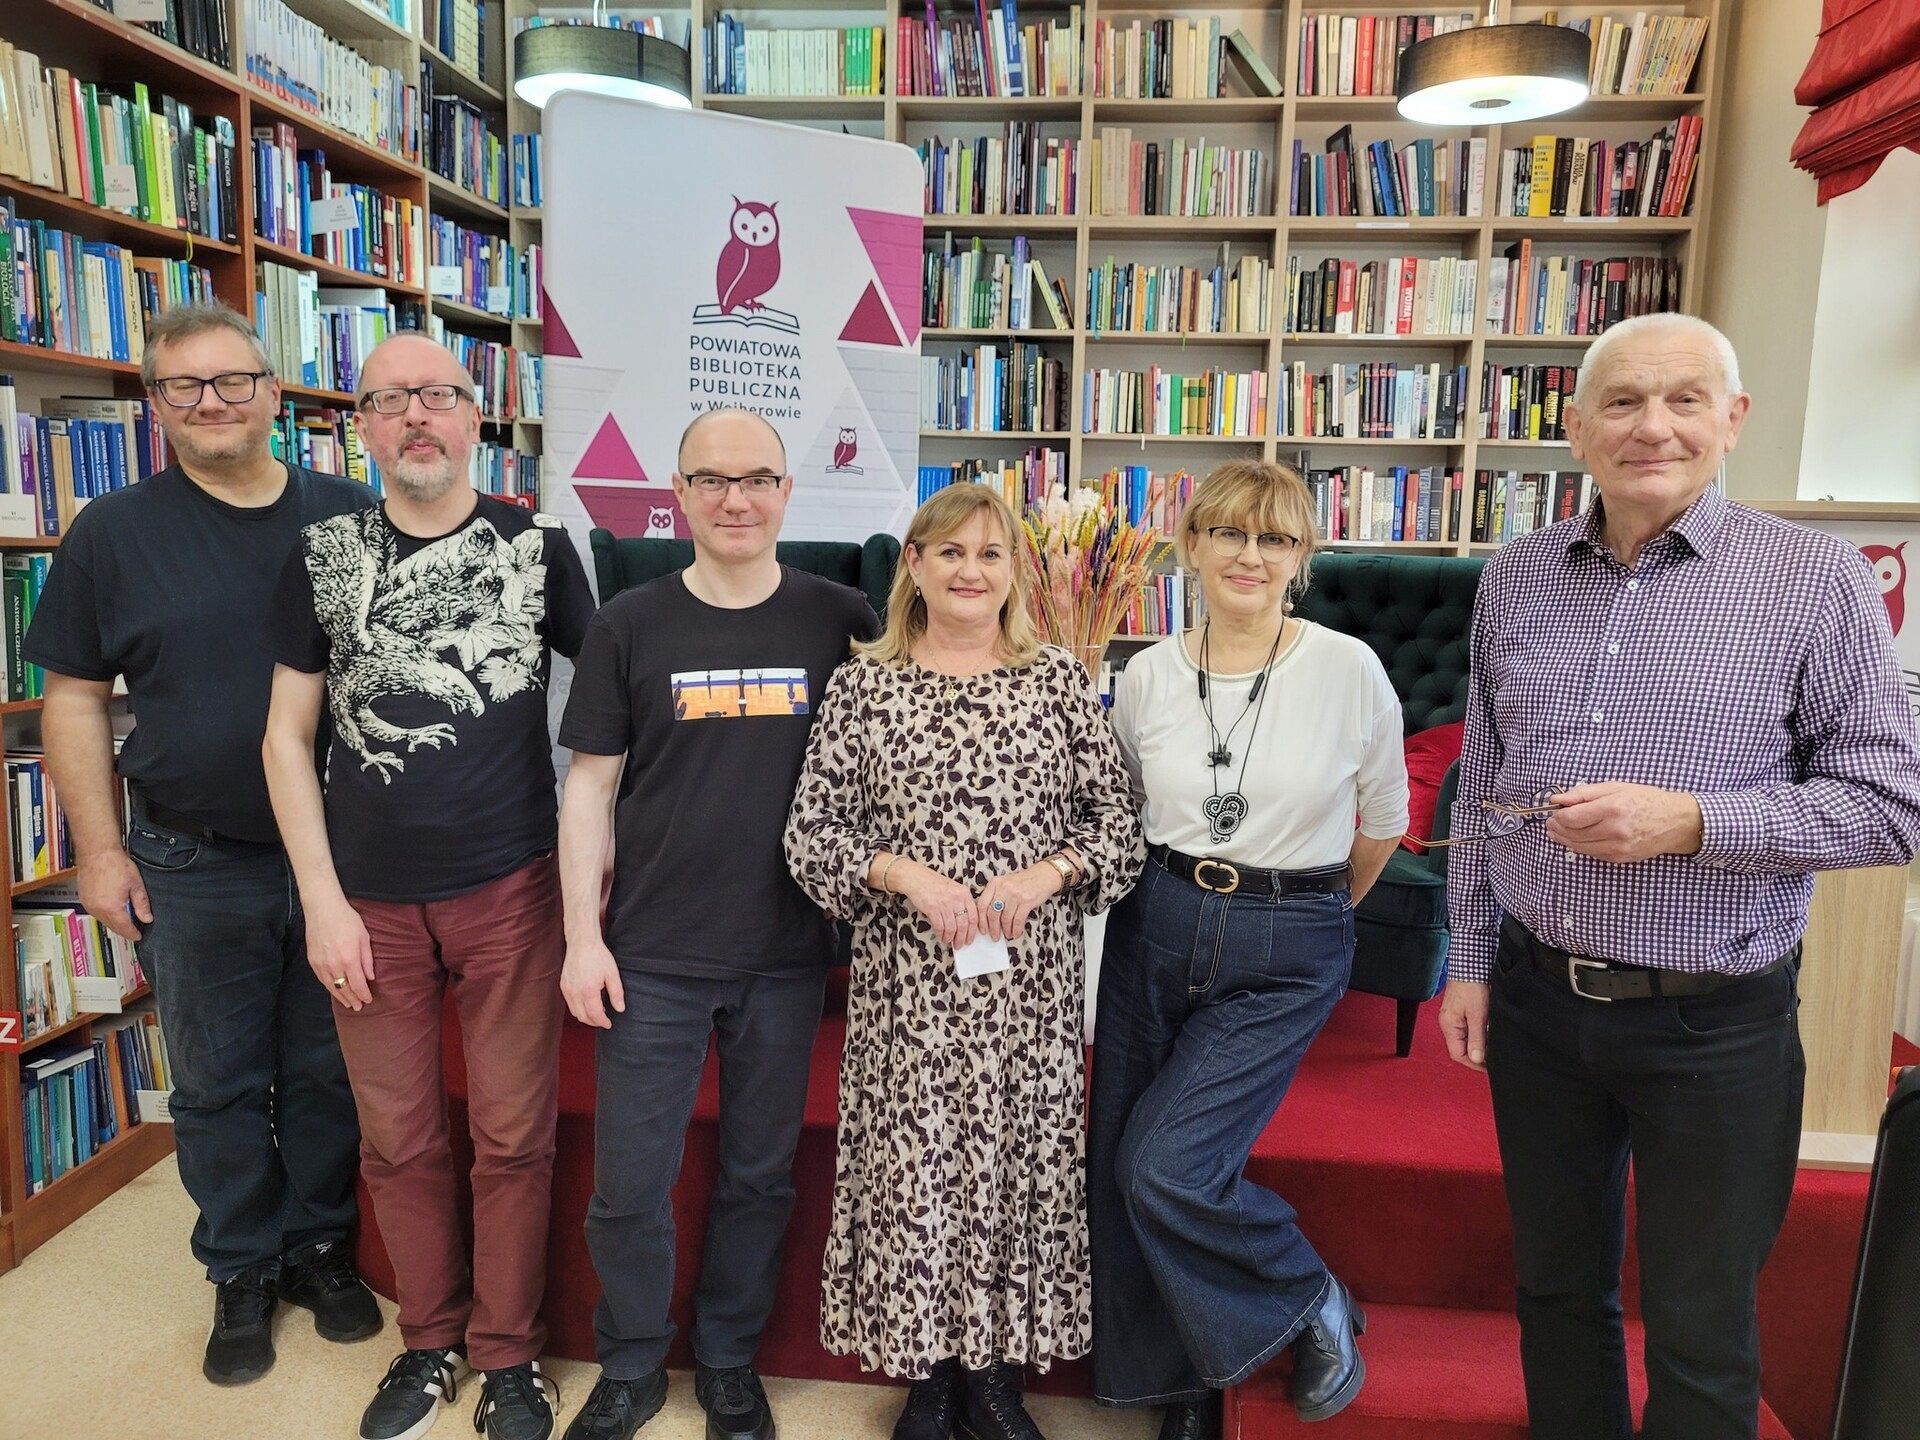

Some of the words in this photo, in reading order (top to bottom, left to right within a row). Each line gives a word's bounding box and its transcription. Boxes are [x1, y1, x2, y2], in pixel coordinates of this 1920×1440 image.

[690, 335, 801, 360] POWIATOWA
[690, 356, 801, 380] BIBLIOTEKA
[690, 378, 801, 400] PUBLICZNA
[690, 402, 702, 412] w
[1546, 390, 1559, 424] ARNHEM
[1476, 489, 1487, 528] BARBAROSSA
[0, 1018, 17, 1044] Z
